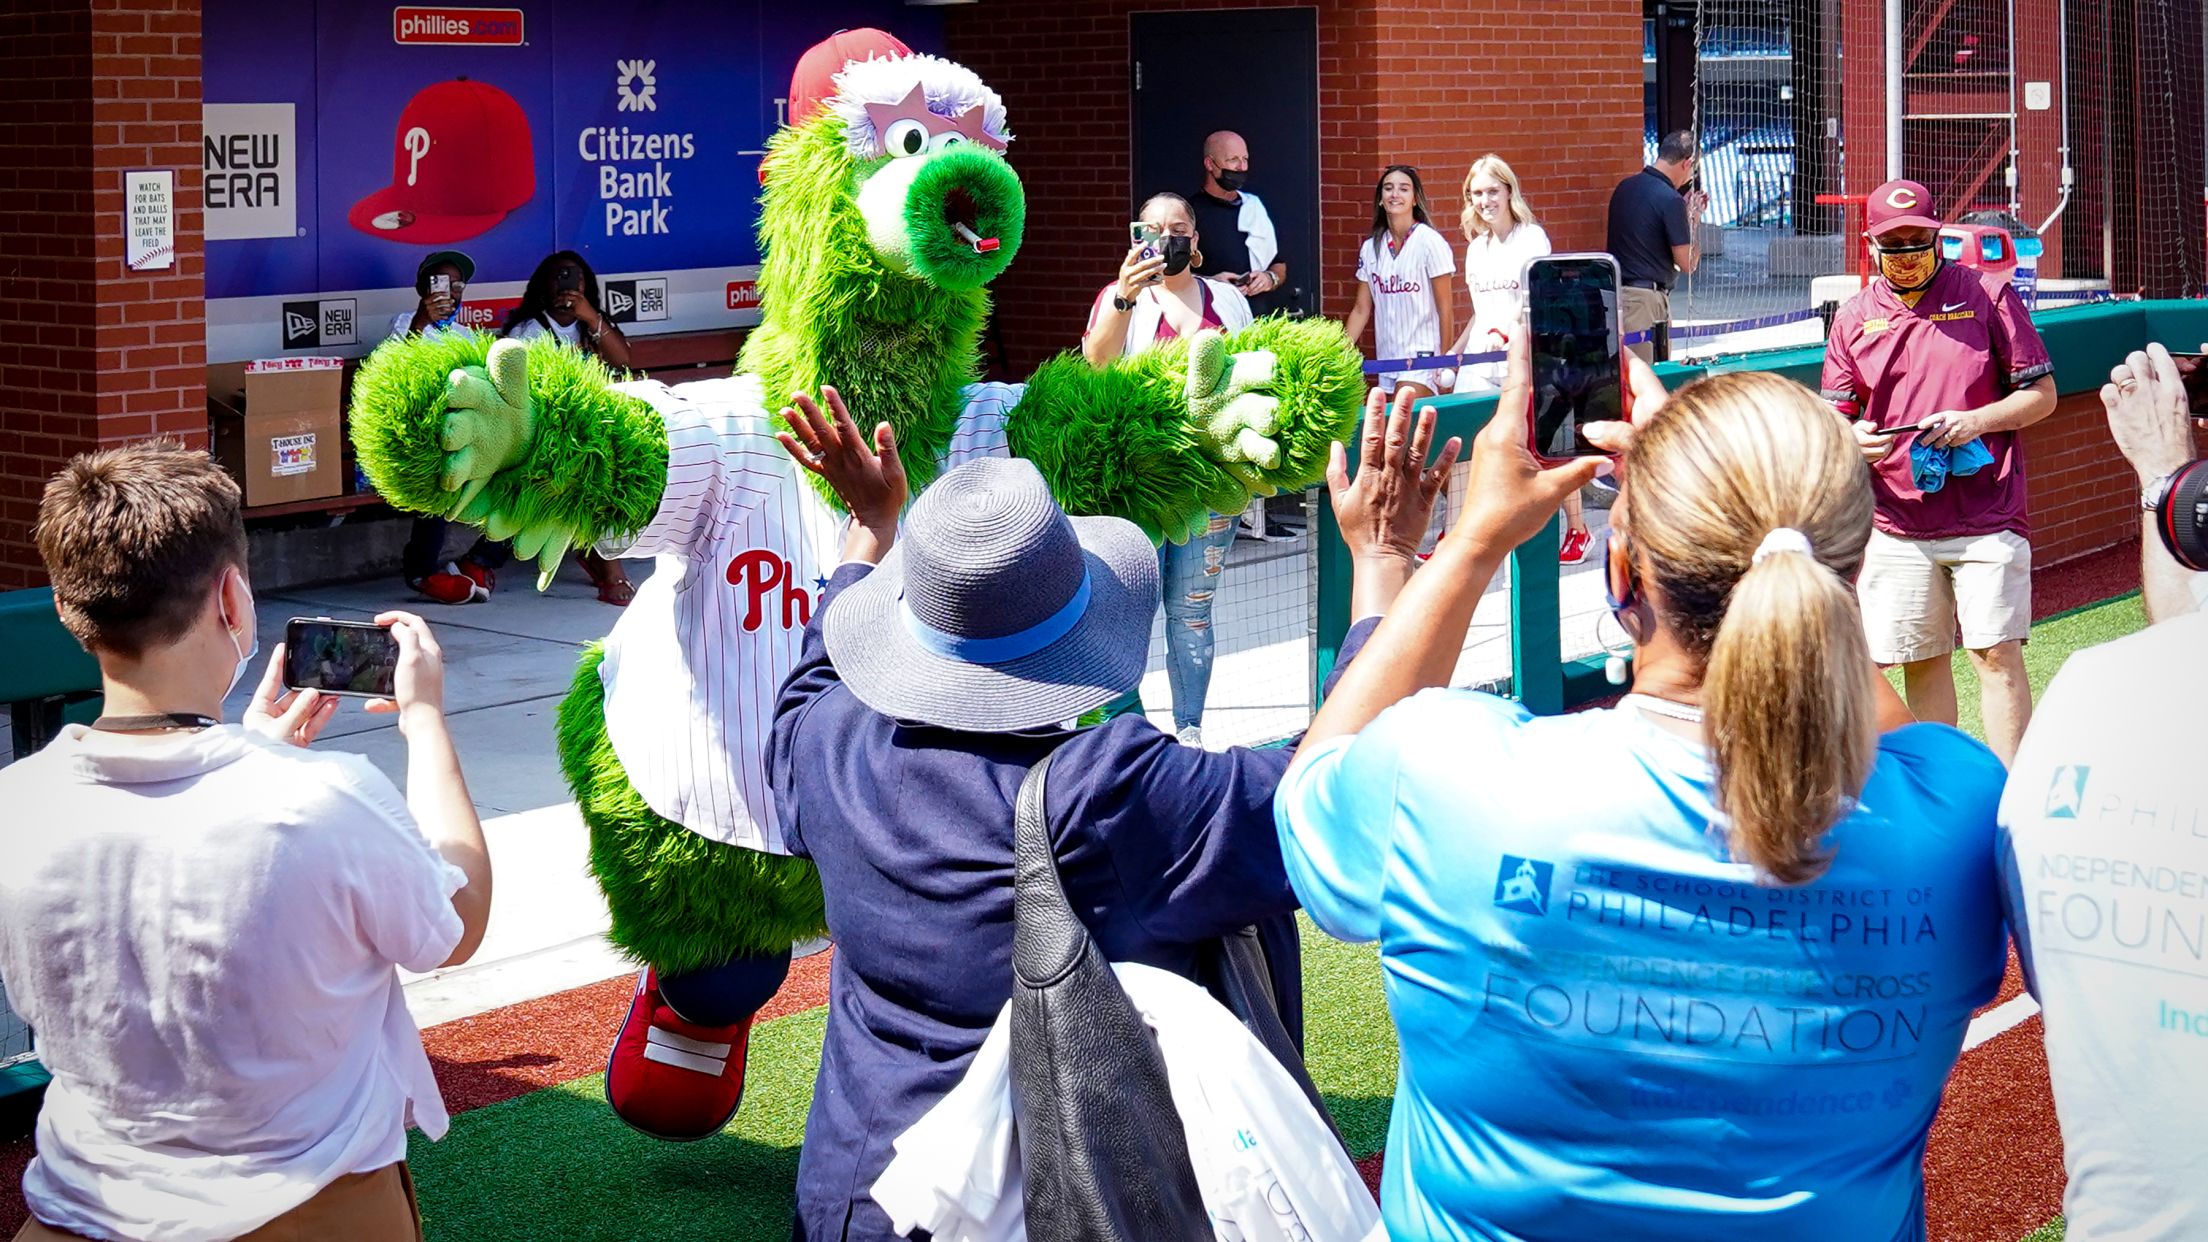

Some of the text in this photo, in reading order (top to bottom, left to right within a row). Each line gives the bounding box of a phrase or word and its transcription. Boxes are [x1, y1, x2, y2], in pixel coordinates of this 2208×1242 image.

[400, 14, 518, 39] phillies.com
[204, 133, 279, 170] NEW
[578, 126, 695, 161] Citizens
[138, 182, 161, 192] WATCH
[204, 172, 280, 209] ERA
[600, 161, 673, 199] Bank
[133, 204, 168, 214] AND BALLS
[134, 193, 165, 204] FOR BATS
[1886, 188, 1917, 209] C
[134, 215, 167, 225] THAT MAY
[605, 198, 670, 236] Park
[135, 226, 166, 237] LEAVE THE
[142, 238, 159, 248] FIELD
[641, 287, 664, 300] NEW
[1371, 272, 1421, 294] Phillies
[325, 309, 352, 323] NEW
[641, 300, 664, 313] ERA
[325, 322, 352, 336] ERA
[1637, 875, 1750, 899] SCHOOL
[1767, 888, 1893, 908] DISTRICT
[1906, 886, 1934, 906] OF
[1567, 890, 1937, 946] PHILADELPHIA
[1831, 971, 1932, 999] CROSS
[1483, 972, 1928, 1053] FOUNDATION
